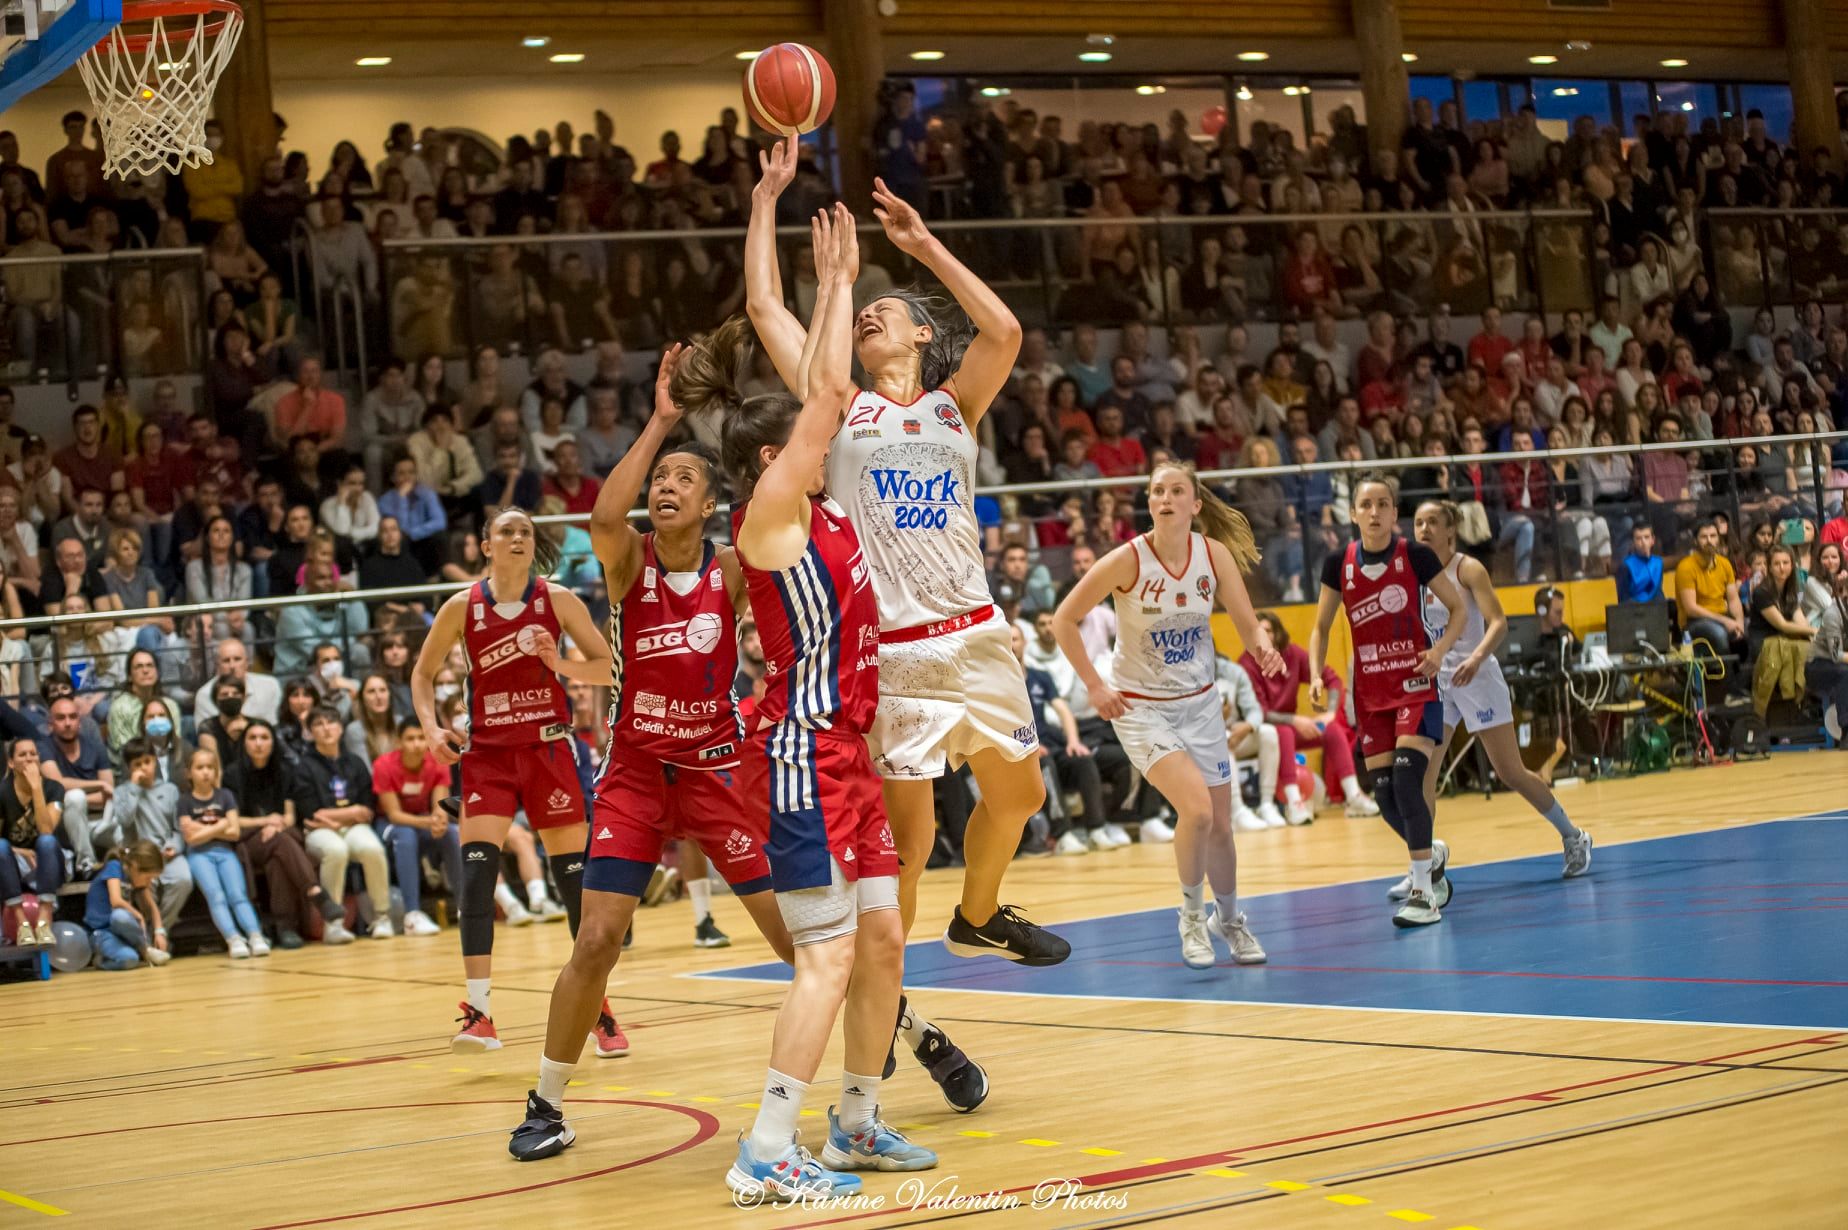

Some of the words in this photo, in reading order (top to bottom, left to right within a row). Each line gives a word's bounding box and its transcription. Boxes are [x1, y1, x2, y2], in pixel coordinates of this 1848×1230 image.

[848, 405, 887, 427] 21
[870, 468, 962, 509] Work
[895, 505, 947, 530] 2000
[1140, 578, 1166, 603] 14
[1351, 601, 1379, 624] SIG
[635, 631, 686, 654] SIG
[1150, 626, 1202, 649] Work
[1378, 640, 1414, 653] ALCYS
[479, 641, 517, 669] SIG
[1389, 656, 1418, 671] Mutuel
[511, 688, 552, 703] ALCYS
[669, 699, 718, 714] ALCYS
[484, 715, 514, 727] Crédit
[523, 709, 556, 721] Mutuel
[633, 717, 665, 735] Crédit
[678, 722, 713, 739] Mutuel
